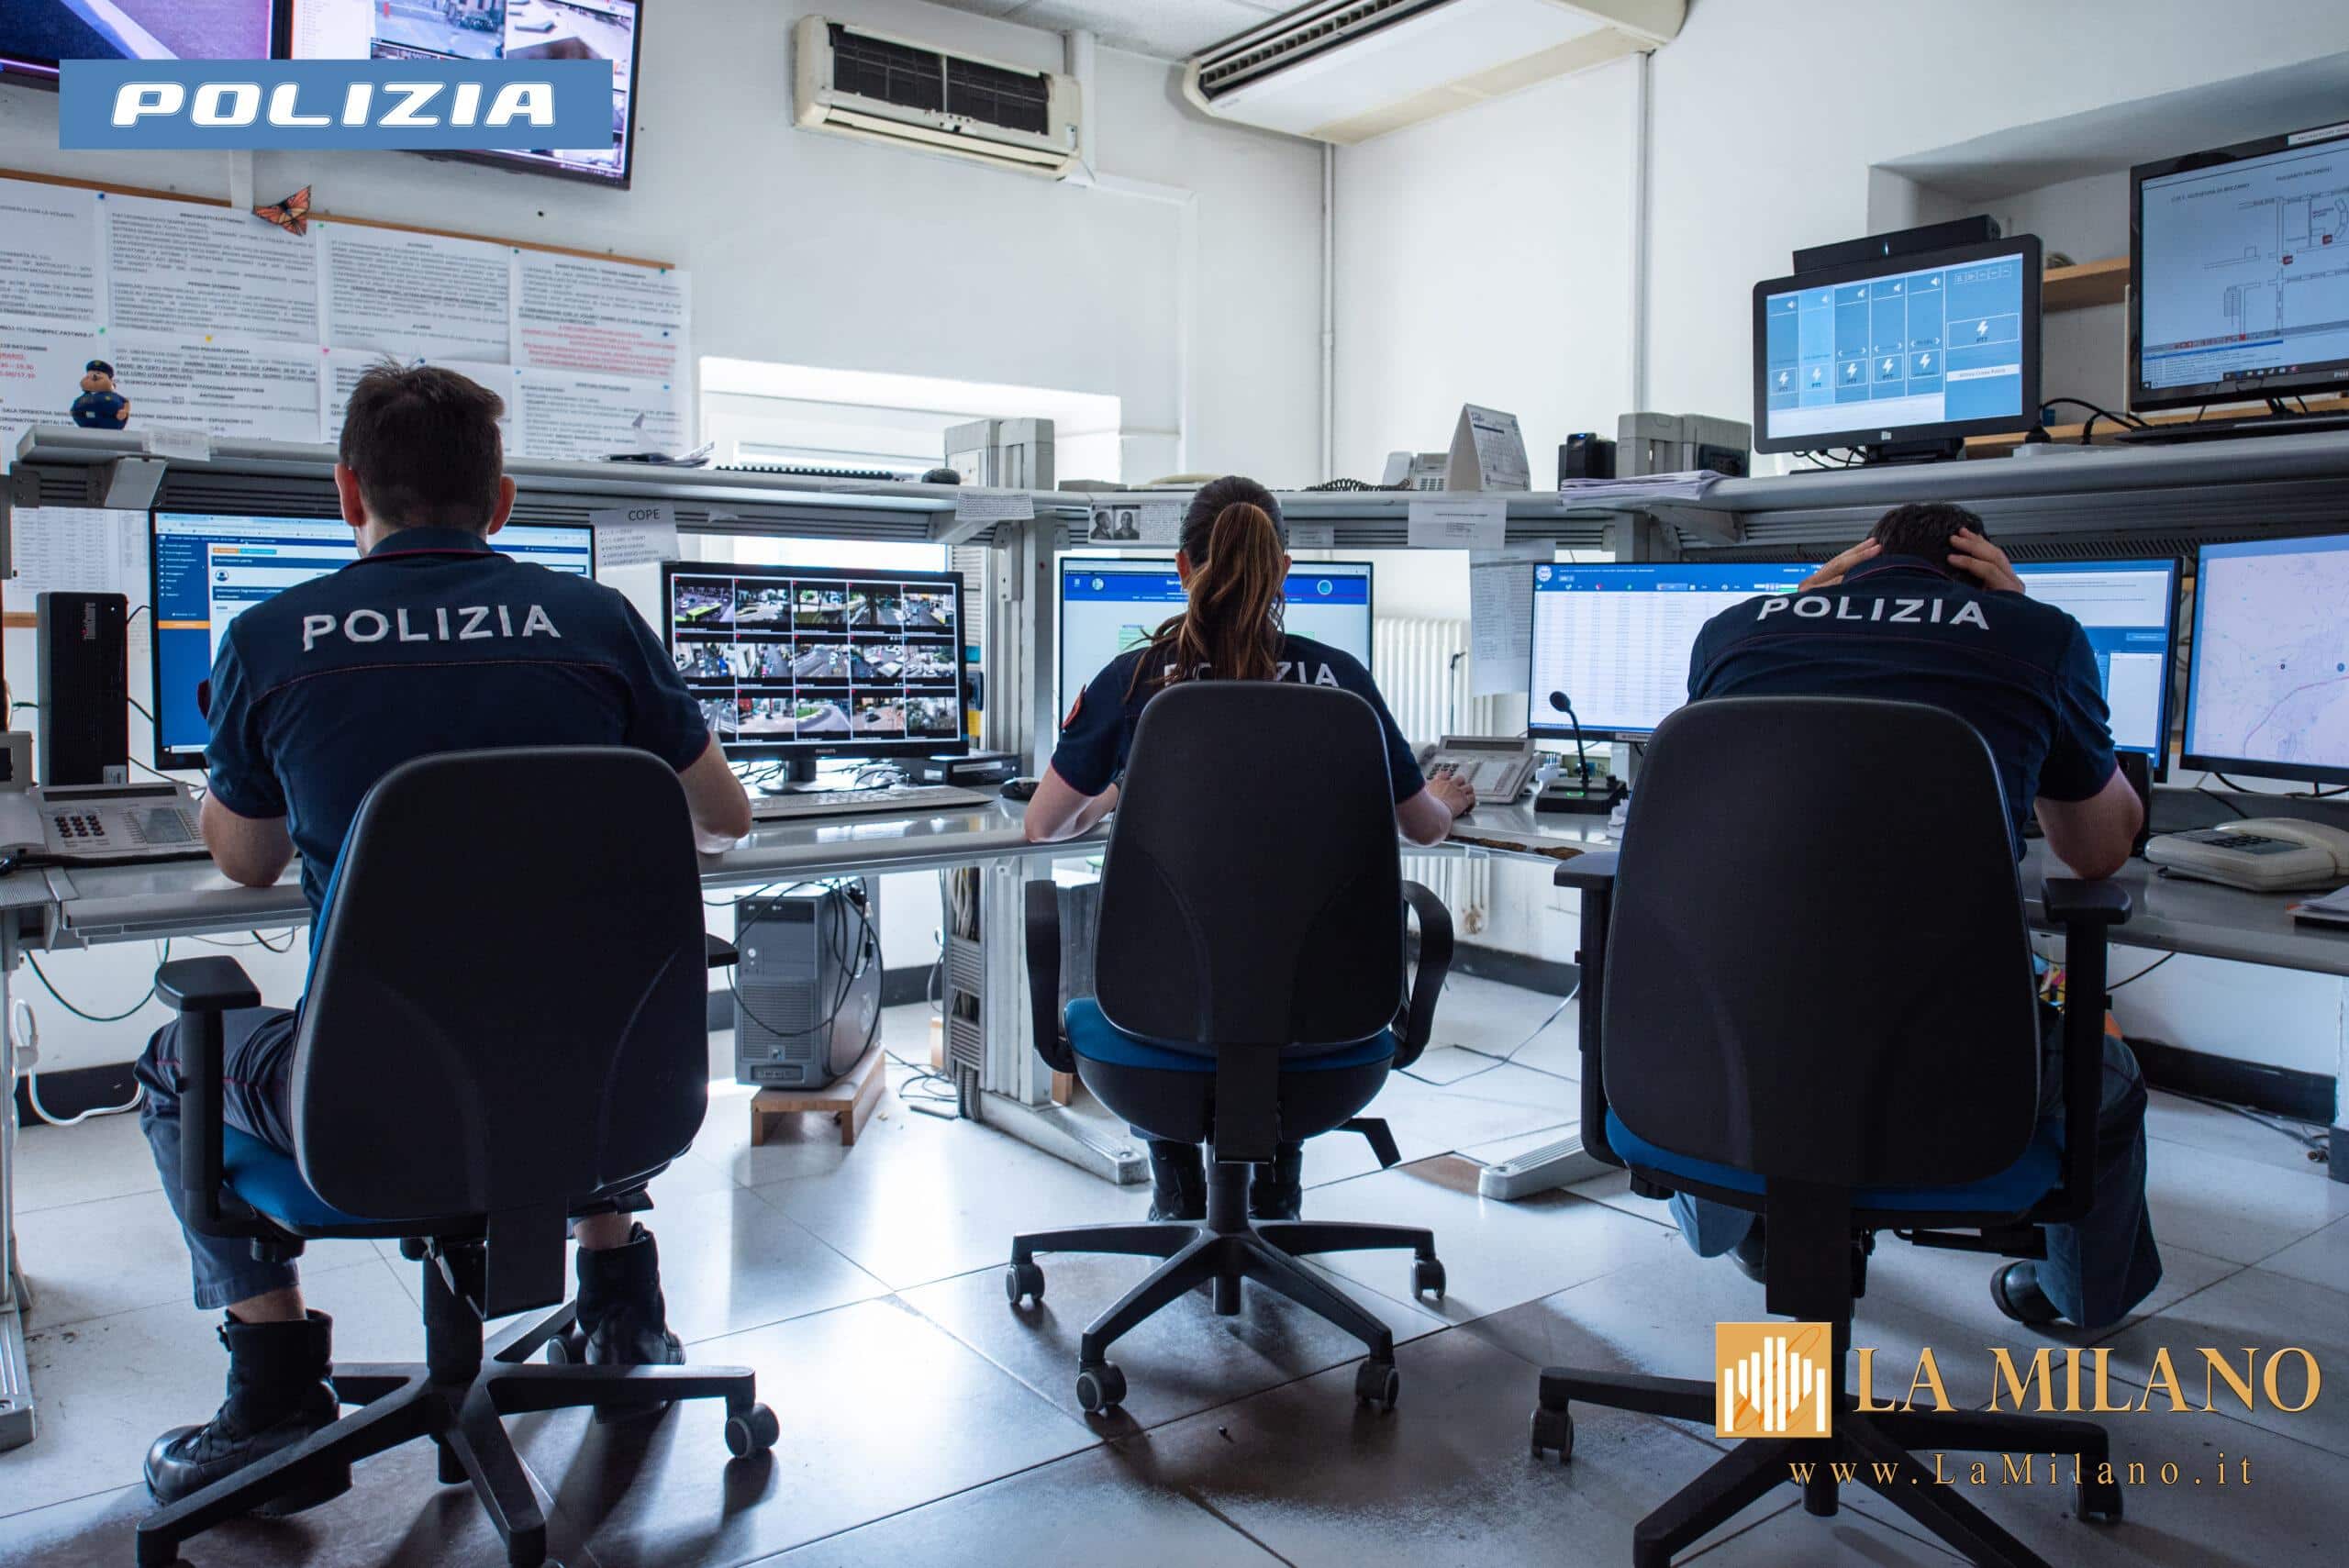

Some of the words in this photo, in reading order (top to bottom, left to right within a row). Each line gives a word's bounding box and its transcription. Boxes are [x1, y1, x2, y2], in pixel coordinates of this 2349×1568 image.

[629, 509, 661, 521] COPE
[303, 605, 562, 652] POLIZIA
[1756, 596, 1990, 630] POLIZIA
